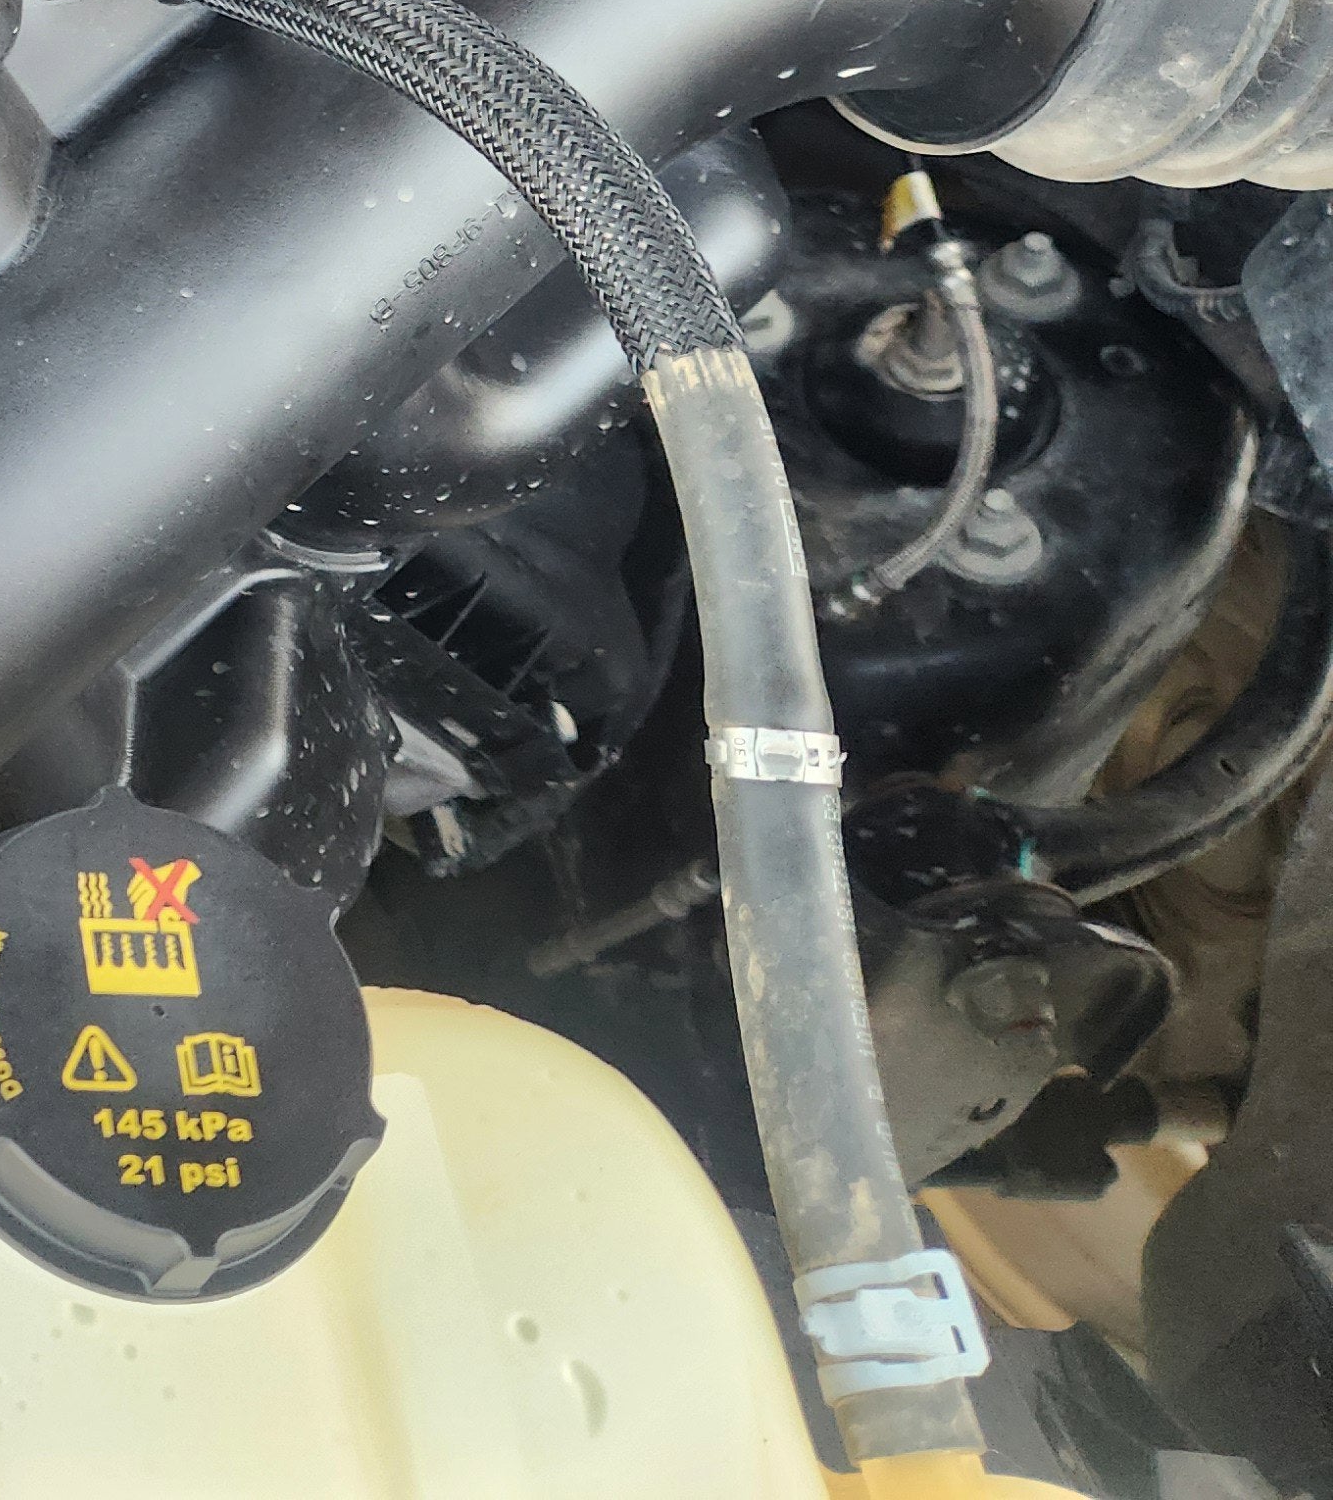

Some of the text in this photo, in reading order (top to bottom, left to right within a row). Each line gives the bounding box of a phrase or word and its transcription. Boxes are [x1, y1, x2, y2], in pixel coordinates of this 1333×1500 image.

[733, 736, 747, 767] OET
[93, 1108, 254, 1142] 145 kPa
[118, 1154, 242, 1193] 21 psi
